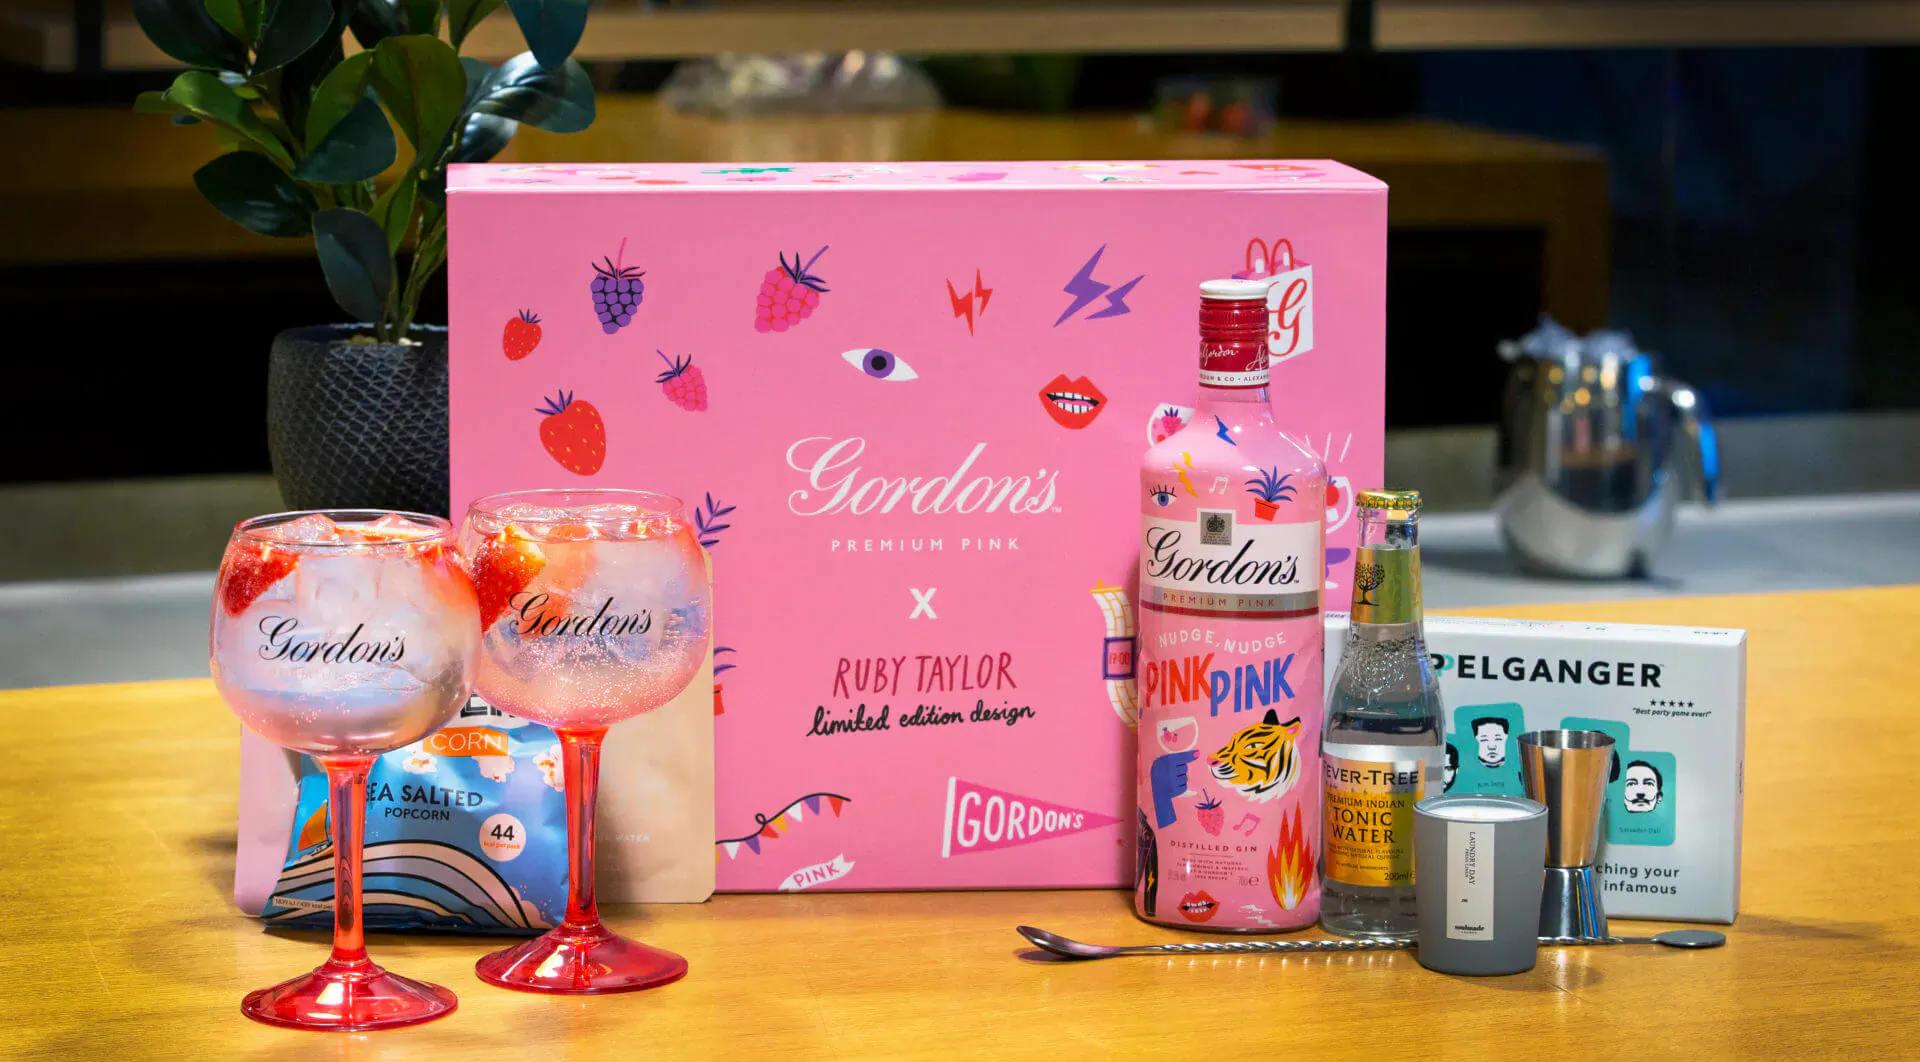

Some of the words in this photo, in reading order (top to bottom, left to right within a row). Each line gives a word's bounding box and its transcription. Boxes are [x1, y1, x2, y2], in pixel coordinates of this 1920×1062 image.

[786, 436, 1059, 516] Gordon's
[831, 538, 943, 552] PREMIUM
[962, 538, 1020, 551] PINK
[1146, 526, 1298, 585] Gordon's
[909, 587, 938, 620] X
[1163, 592, 1226, 606] PREMIUM
[1238, 598, 1276, 608] PINK
[509, 591, 652, 637] Gordon's
[258, 615, 406, 664] Gordon's
[1159, 628, 1220, 648] NUDGE,
[1223, 631, 1286, 655] NUDGE
[833, 657, 906, 699] RUBY
[915, 652, 1017, 693] TAYLOR
[1146, 652, 1214, 707] PINK
[1210, 653, 1295, 717] PINK
[806, 703, 890, 737] limited
[900, 704, 964, 727] edition
[970, 700, 1036, 726] design
[1652, 709, 1670, 717] party
[1671, 710, 1690, 718] game
[430, 732, 502, 751] CORN
[401, 785, 483, 807] SALTED
[1366, 800, 1405, 808] INDIAN
[384, 807, 450, 821] POPCORN
[957, 792, 1084, 847] GORDON'S
[1333, 806, 1393, 826] TONIC
[490, 824, 516, 841] 44
[1332, 823, 1395, 844] WATER
[1170, 840, 1230, 852] DISTILLED
[793, 862, 839, 887] PINK
[1644, 867, 1680, 879] your
[1604, 880, 1677, 895] infamous
